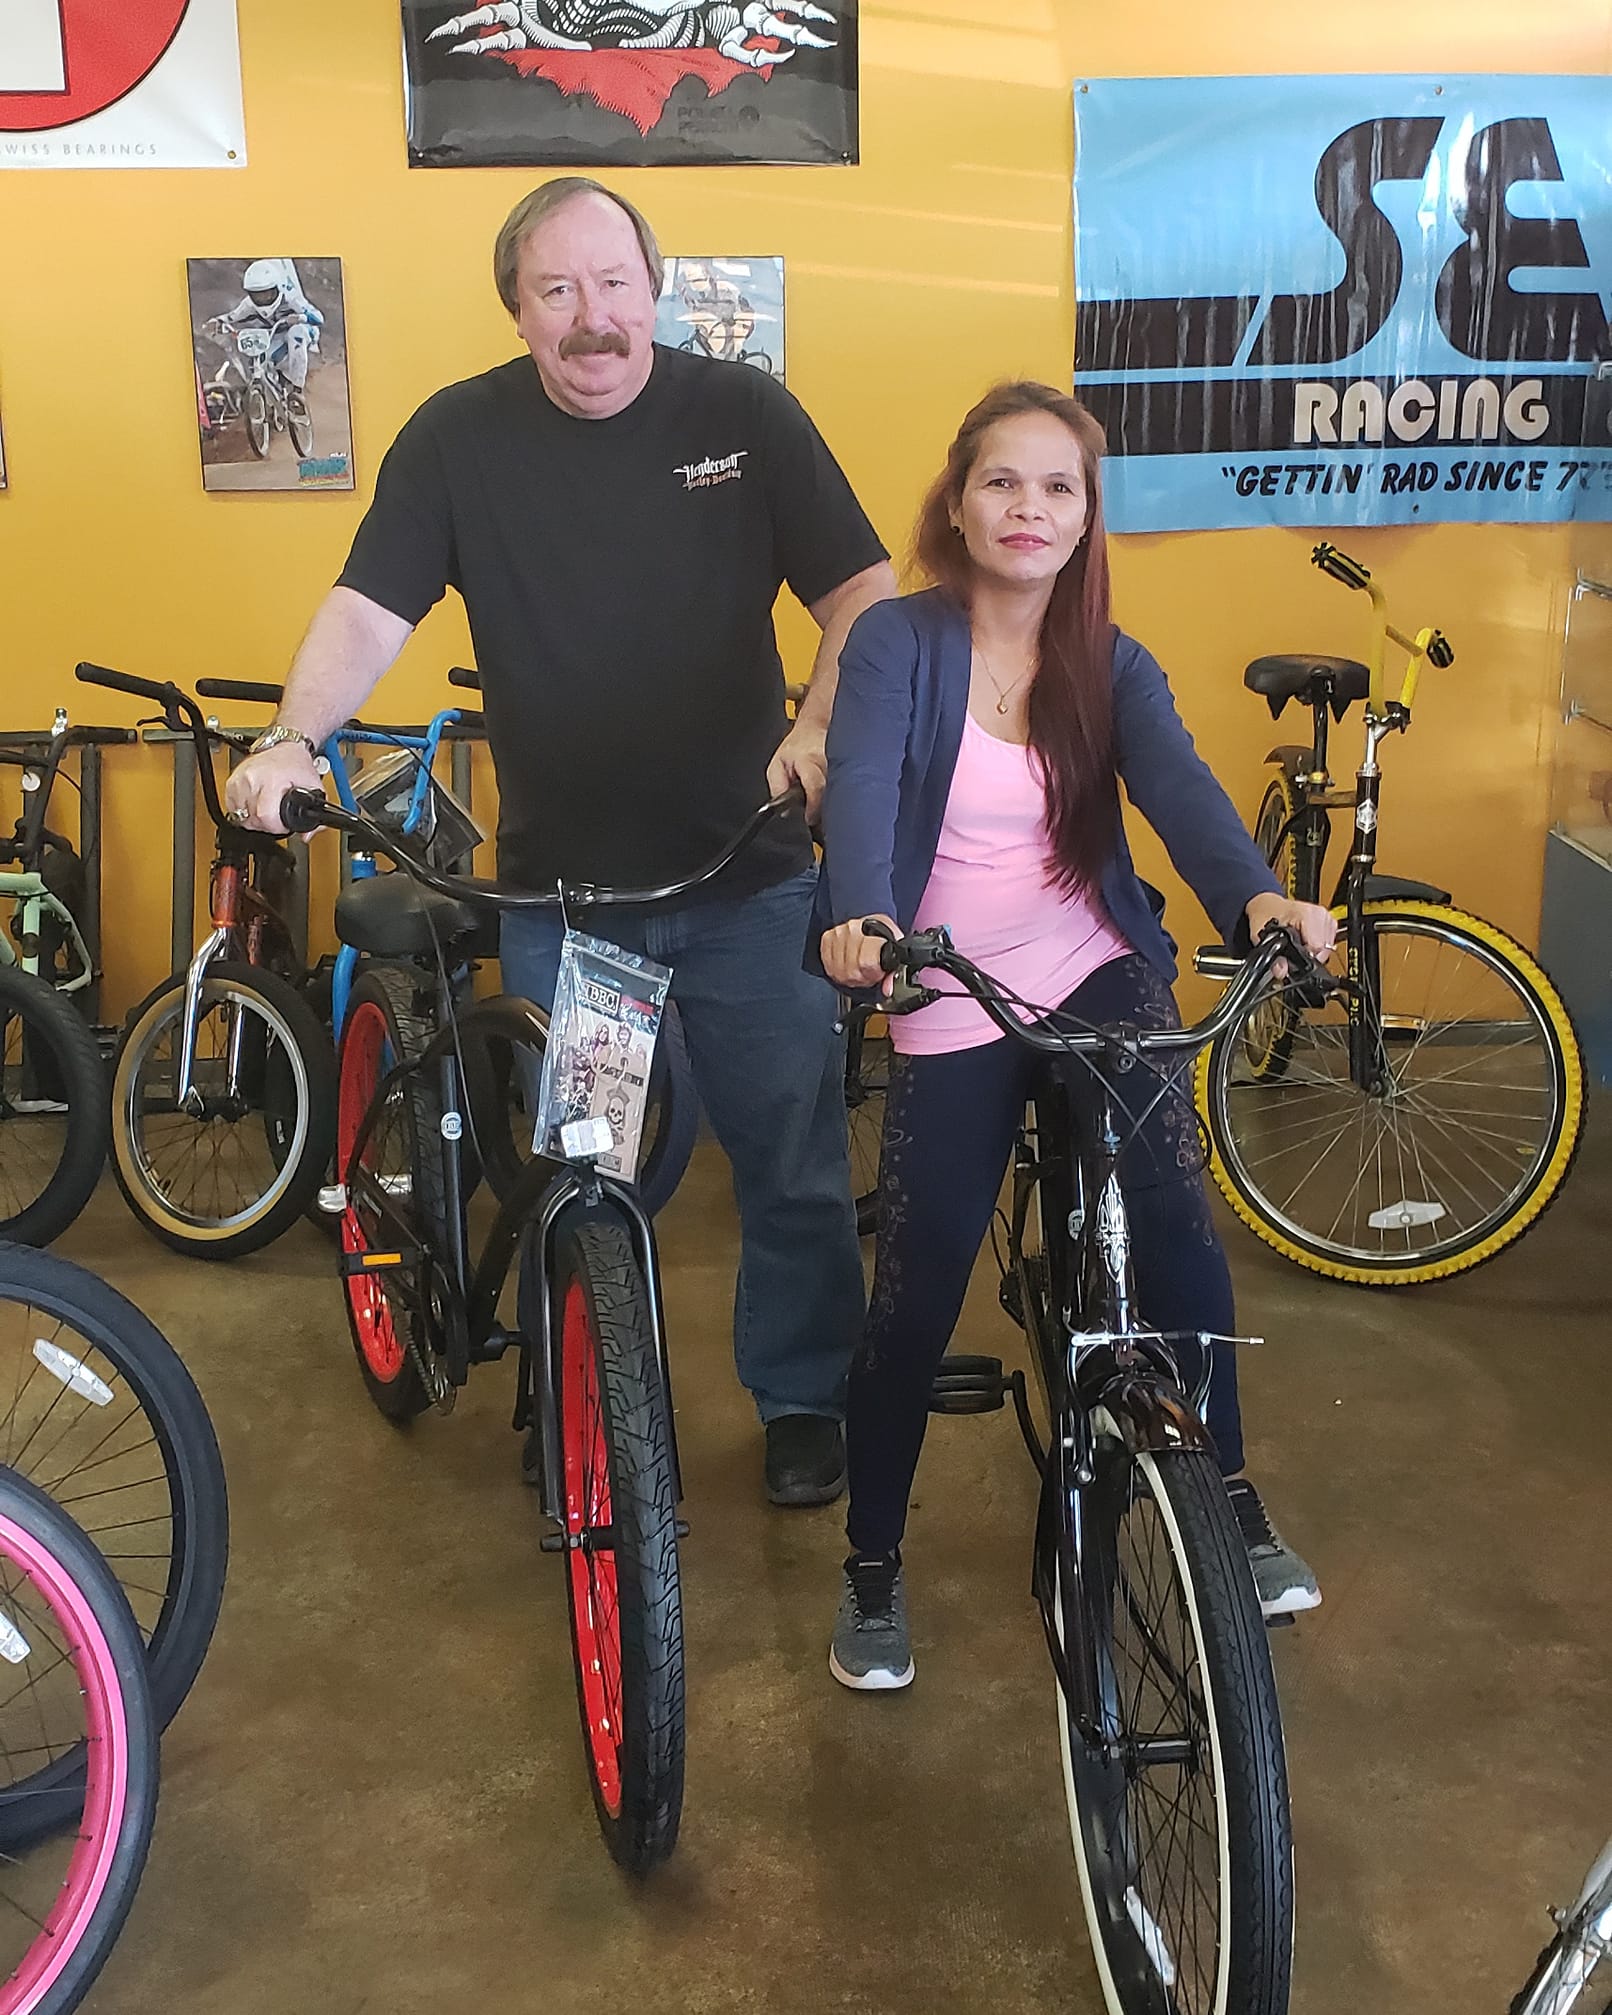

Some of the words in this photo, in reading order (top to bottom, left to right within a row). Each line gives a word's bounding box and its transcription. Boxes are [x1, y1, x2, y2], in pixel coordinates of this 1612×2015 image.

[0, 143, 50, 156] WISS
[62, 143, 158, 156] BEARINGS
[1243, 116, 1612, 366] SE
[1293, 379, 1550, 442] RACING
[1380, 462, 1438, 494] RAD
[1444, 460, 1548, 491] SINCE
